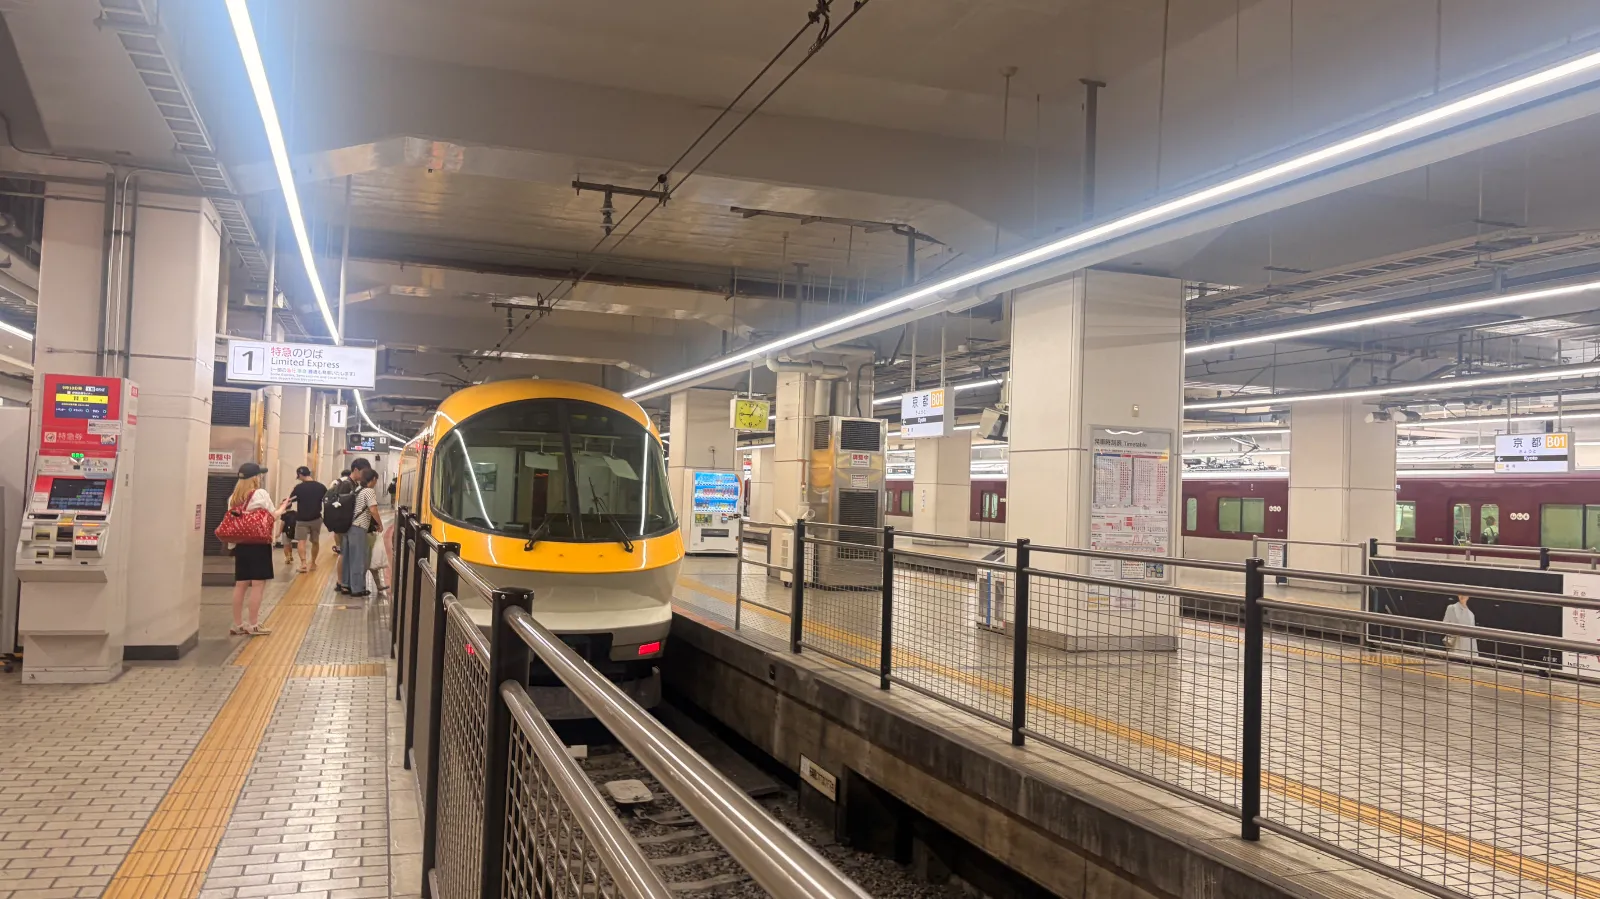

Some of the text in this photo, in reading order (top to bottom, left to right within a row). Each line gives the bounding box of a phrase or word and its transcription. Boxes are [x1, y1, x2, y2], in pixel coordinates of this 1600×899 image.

[271, 346, 324, 359] 特急のりば
[241, 350, 254, 371] 1
[271, 357, 340, 369] Limited Express
[932, 392, 943, 406] B01
[333, 410, 342, 423] 1
[1513, 436, 1565, 448] 京都 B01
